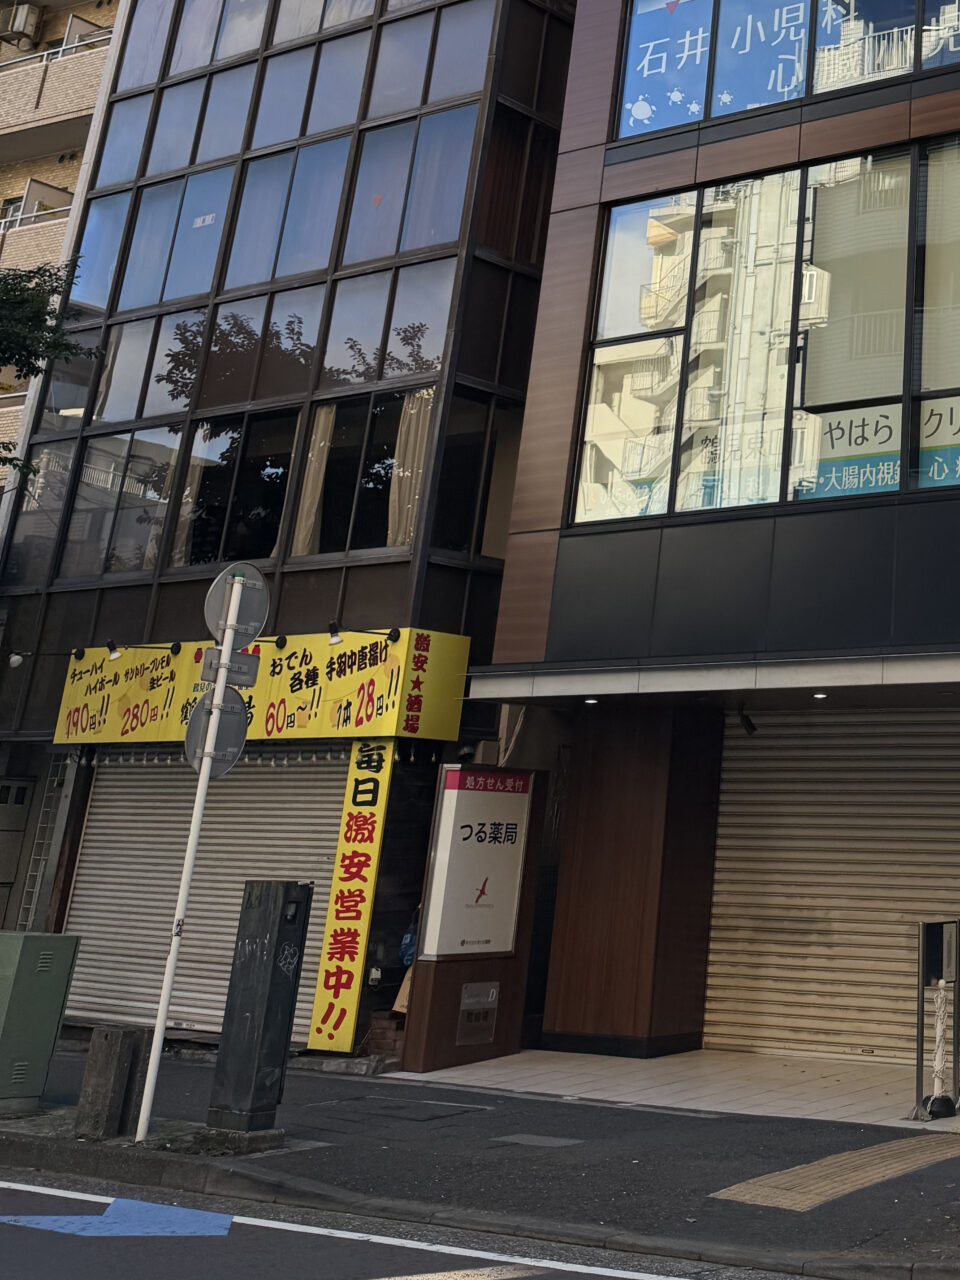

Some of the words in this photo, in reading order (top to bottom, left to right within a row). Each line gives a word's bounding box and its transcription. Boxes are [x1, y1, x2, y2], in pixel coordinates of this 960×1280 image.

[70, 657, 106, 685] チューハイ
[269, 648, 313, 677] おでん
[84, 671, 120, 697] ハイボール
[149, 669, 176, 692] 生ビール
[289, 665, 319, 694] 各種
[465, 776, 524, 792] 処方せん受付
[460, 822, 518, 845] つる薬局
